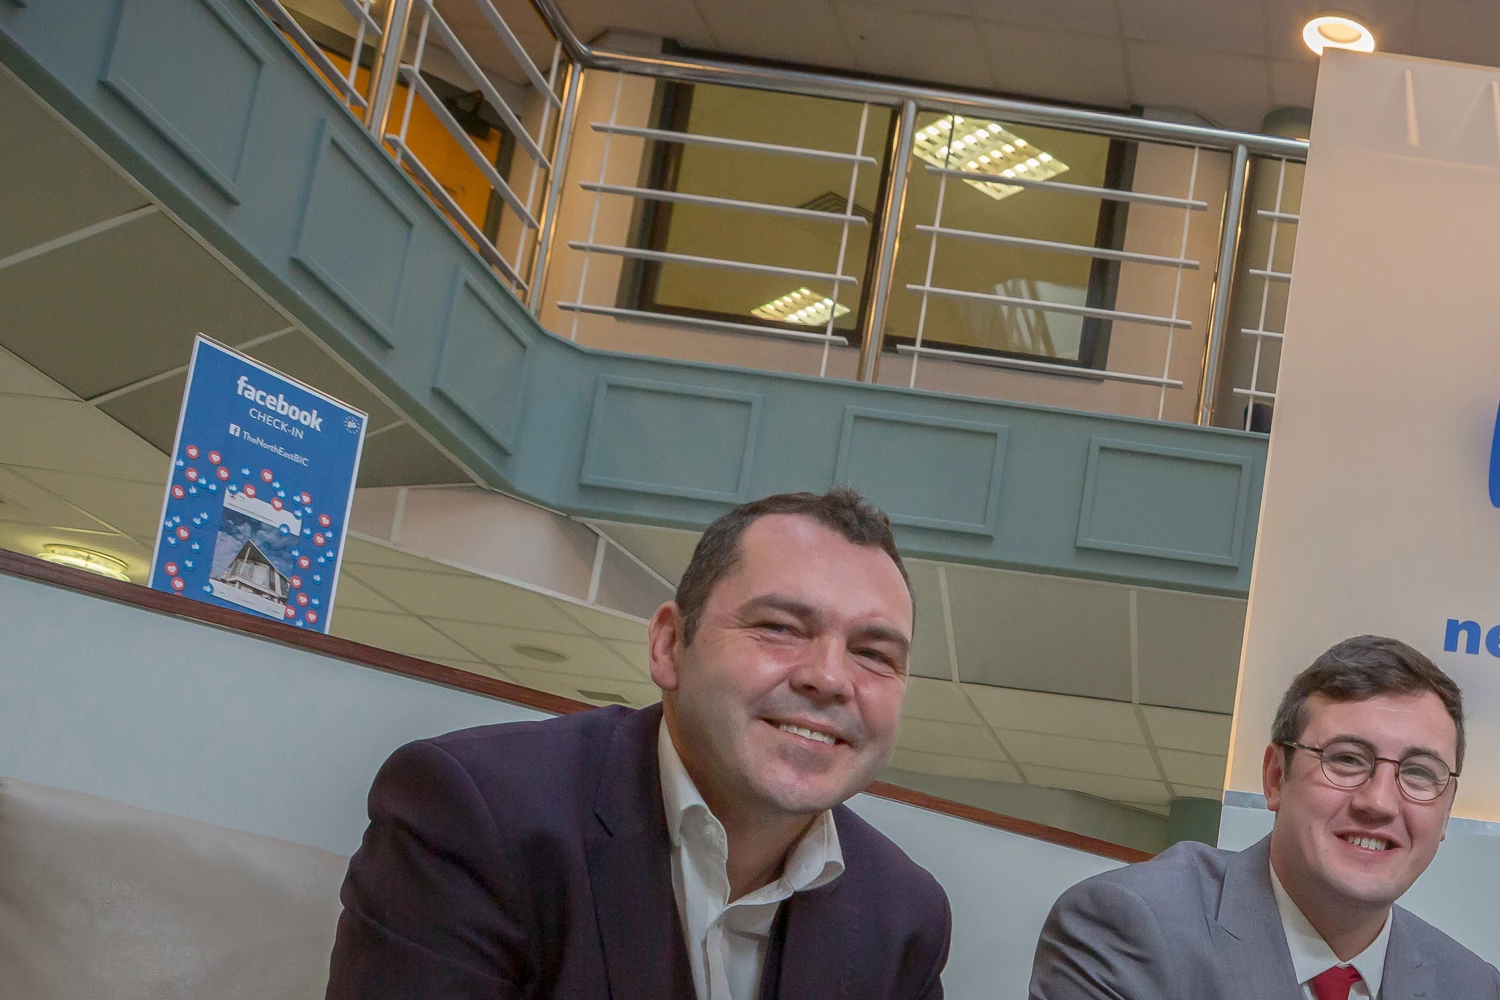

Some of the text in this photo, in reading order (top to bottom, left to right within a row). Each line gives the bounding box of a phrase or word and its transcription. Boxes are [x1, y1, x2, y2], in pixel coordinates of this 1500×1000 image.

[237, 375, 323, 432] facebook
[249, 408, 304, 439] CHECK-IN
[243, 430, 309, 467] TheNorthEastBIC
